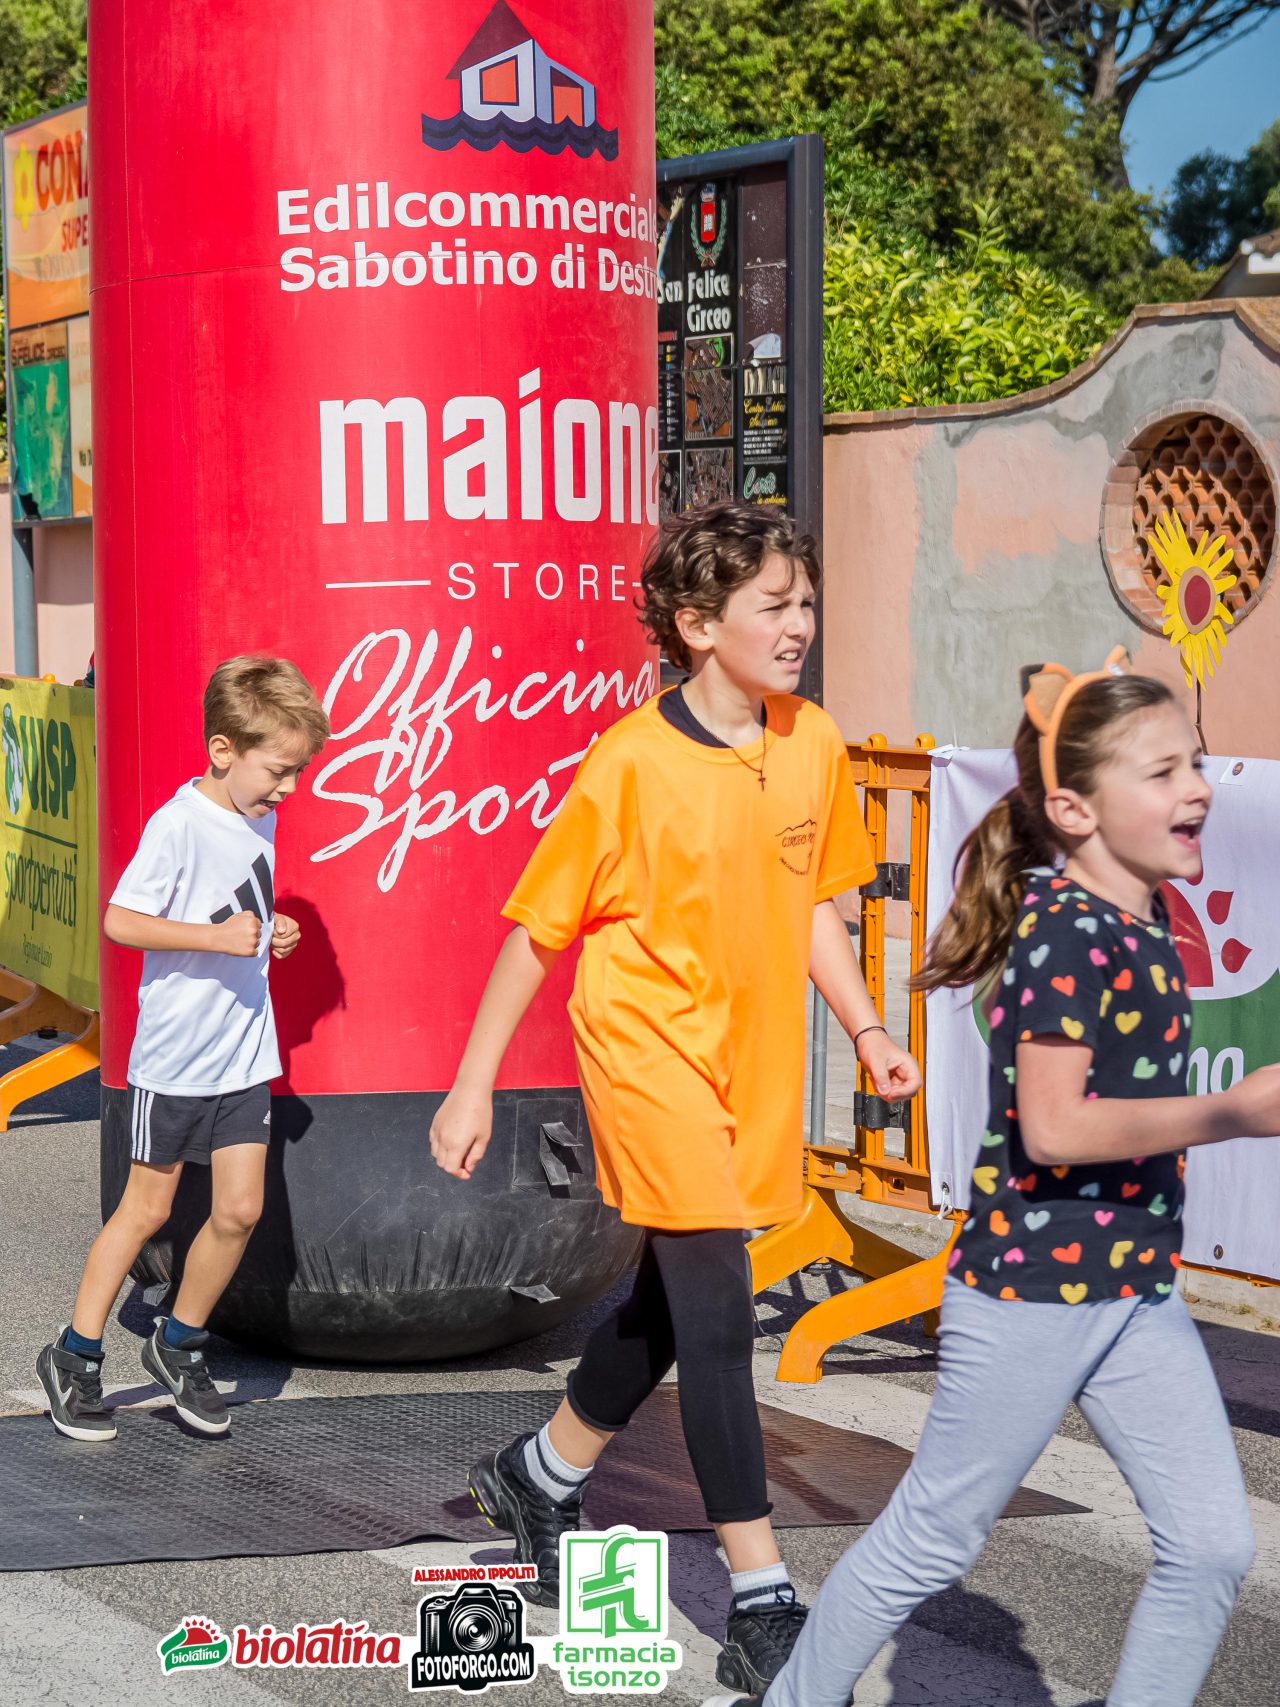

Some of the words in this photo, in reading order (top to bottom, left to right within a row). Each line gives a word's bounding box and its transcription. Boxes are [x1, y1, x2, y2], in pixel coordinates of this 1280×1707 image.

[36, 130, 88, 211] CON
[280, 238, 537, 292] Sabotino
[550, 242, 585, 290] di
[688, 269, 730, 302] Felice
[687, 303, 731, 332] Circeo
[447, 562, 626, 600] STORE
[322, 626, 655, 794] Officina
[20, 715, 76, 820] UISP
[5, 846, 78, 931] sportpertutti
